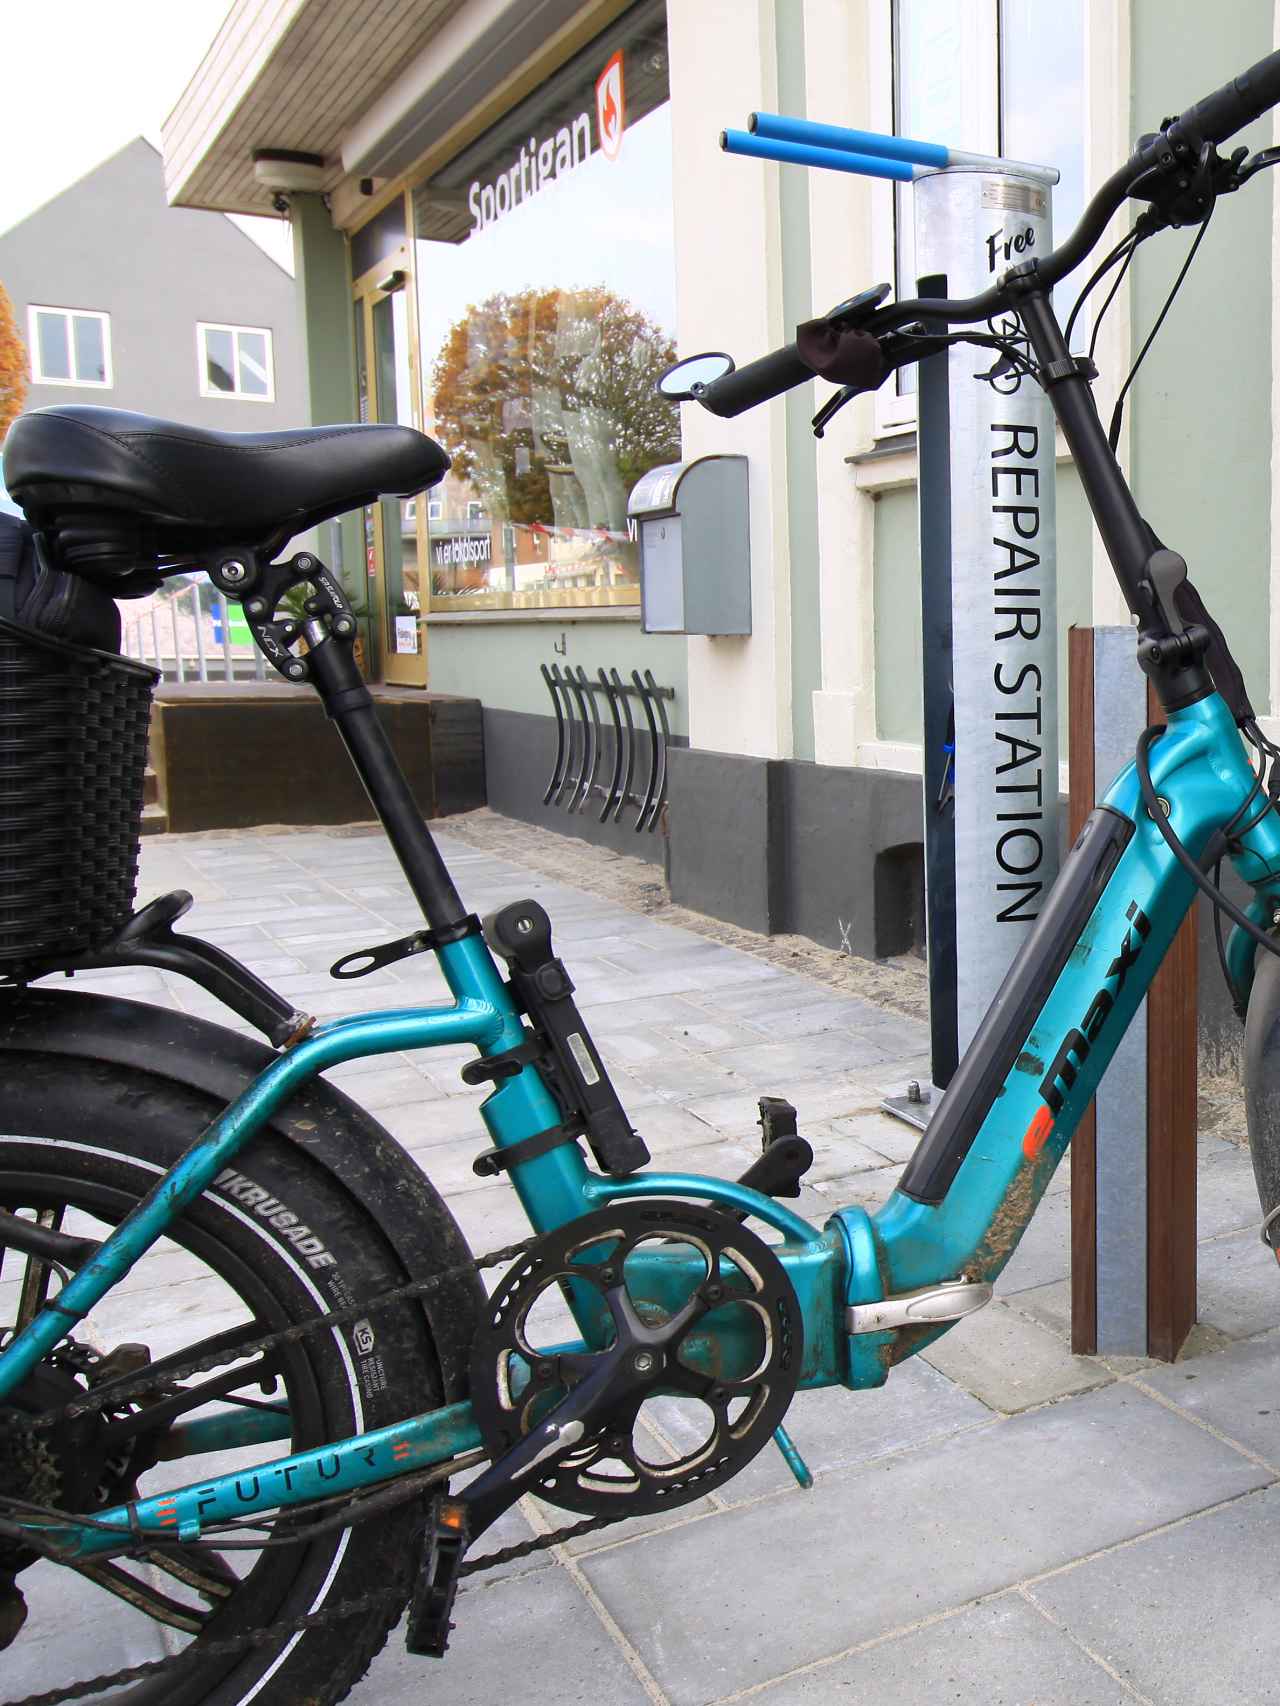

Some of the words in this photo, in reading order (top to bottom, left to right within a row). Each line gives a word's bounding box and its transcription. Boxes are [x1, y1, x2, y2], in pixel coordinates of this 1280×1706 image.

[469, 112, 592, 234] Sportigan
[985, 227, 1035, 273] Free
[990, 423, 1041, 642] REPAIR
[993, 662, 1043, 924] STATION
[221, 1174, 338, 1270] KRUSADE
